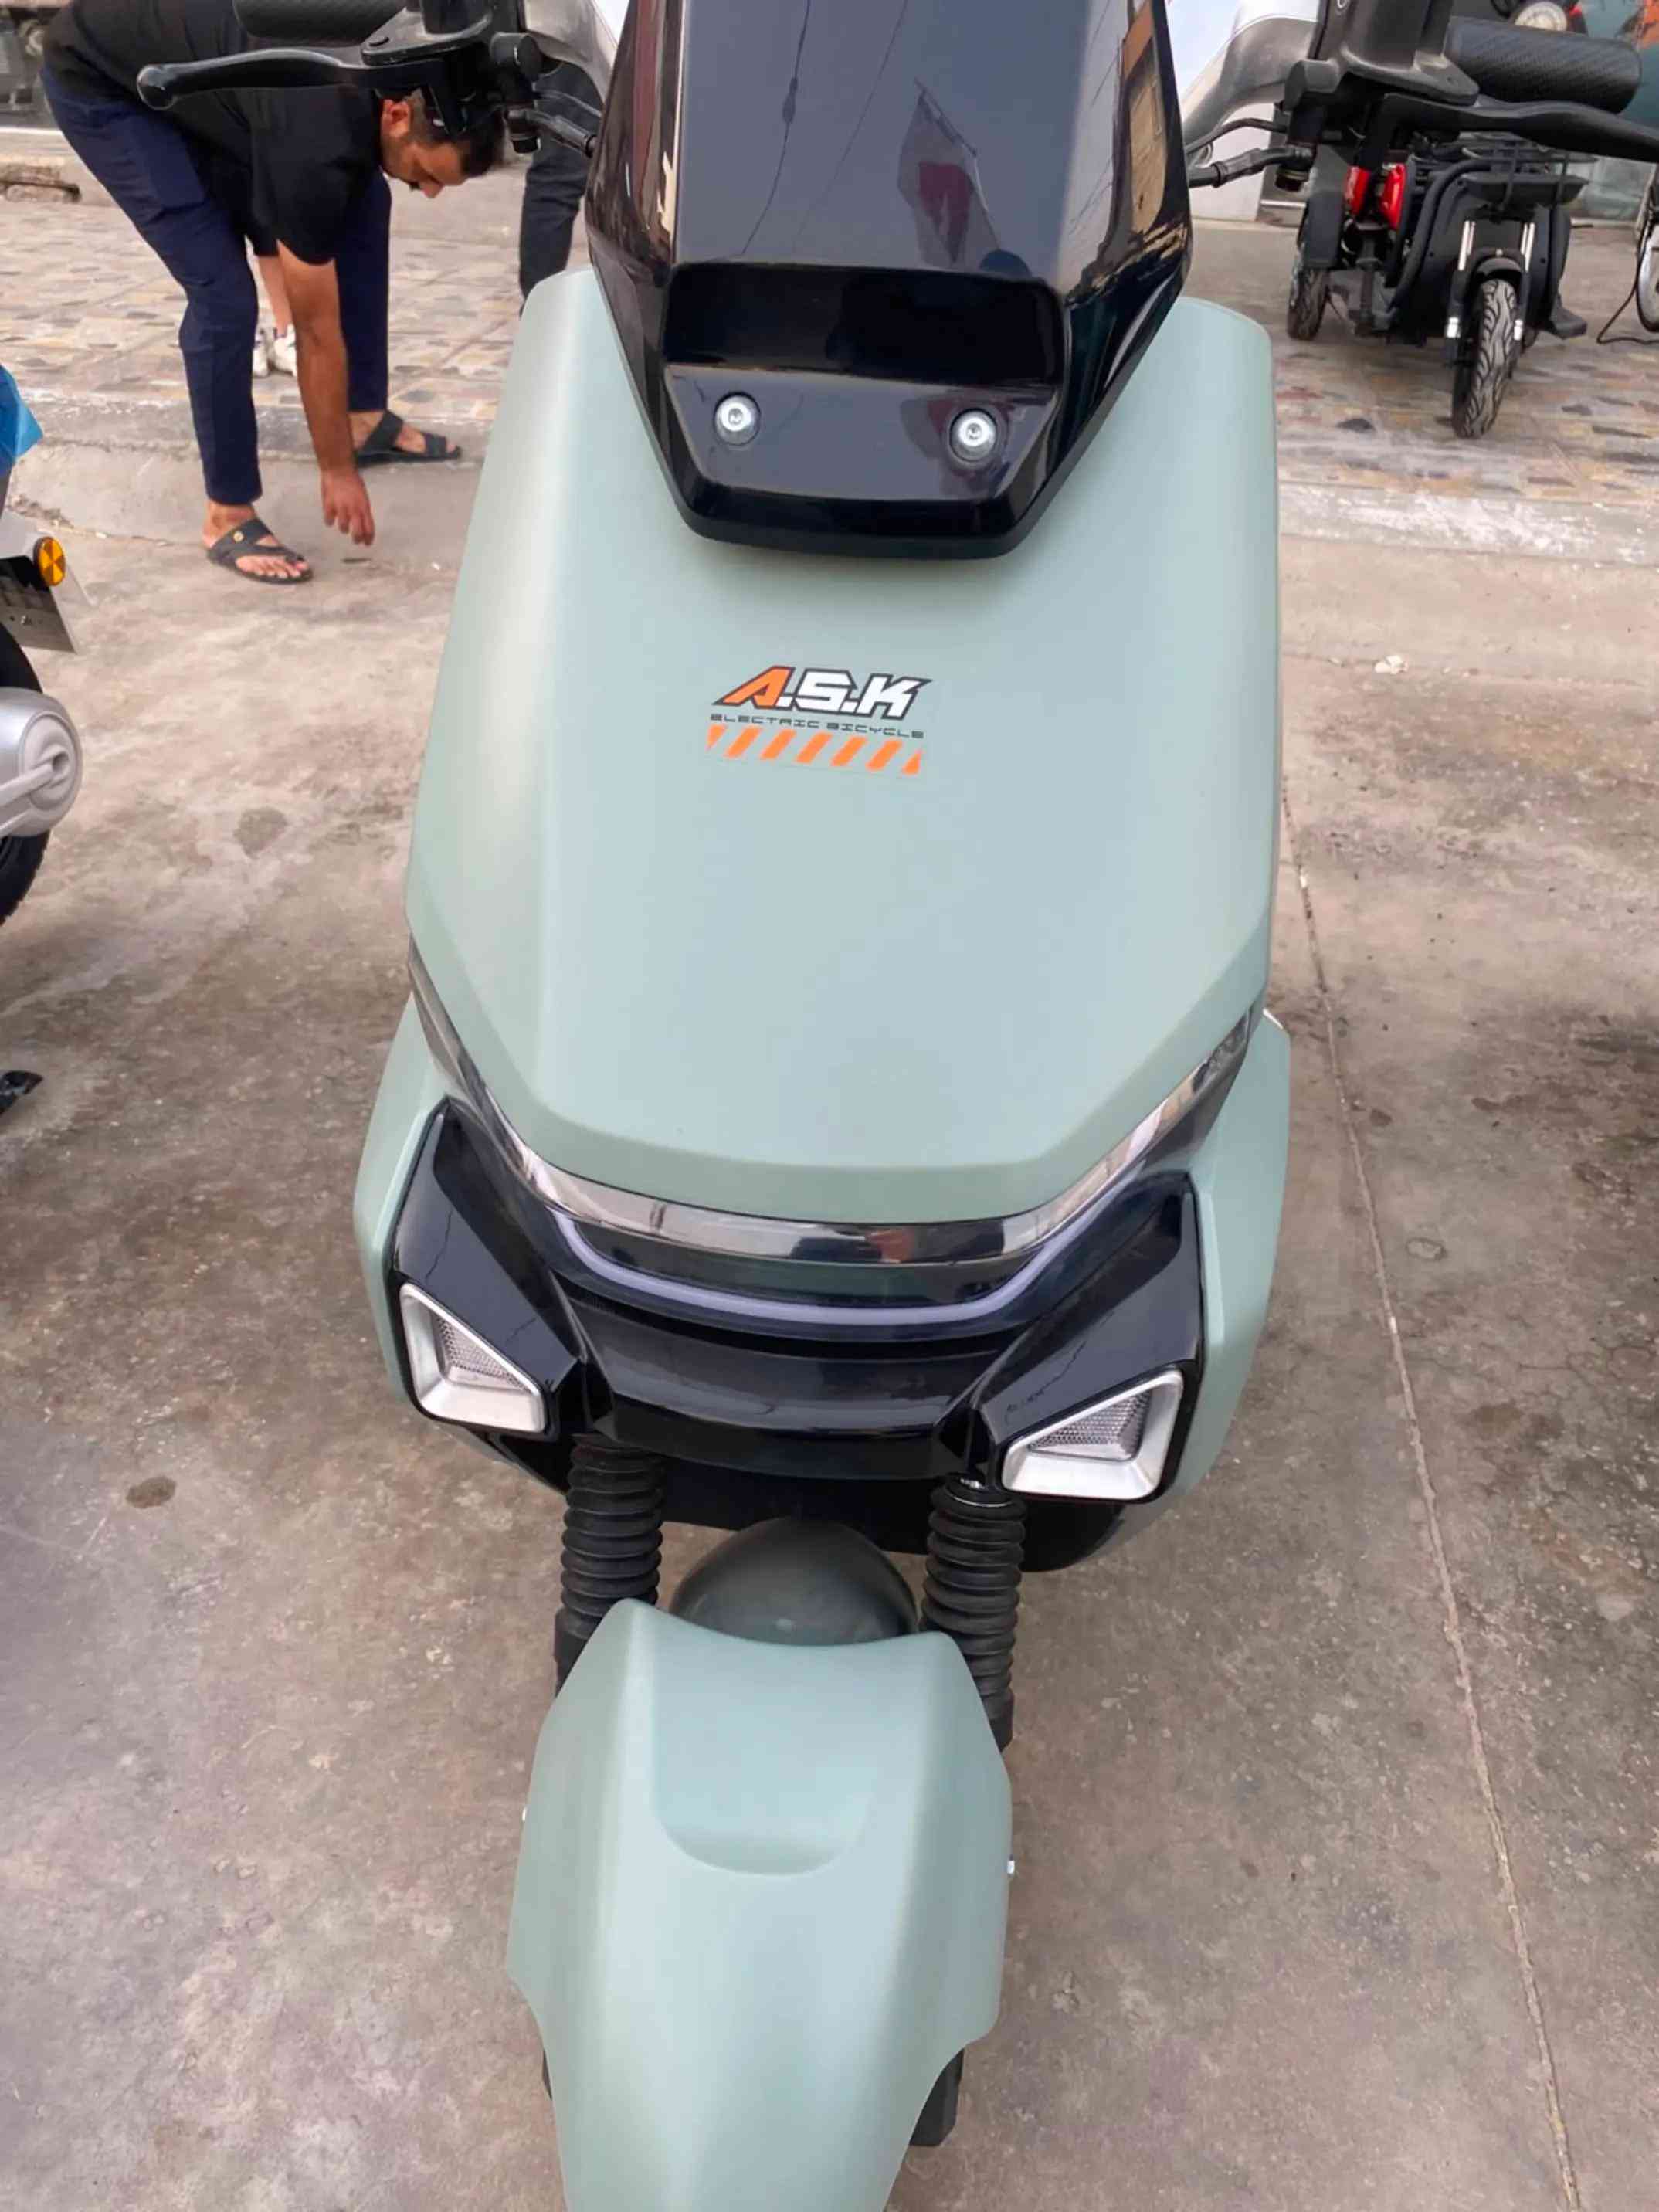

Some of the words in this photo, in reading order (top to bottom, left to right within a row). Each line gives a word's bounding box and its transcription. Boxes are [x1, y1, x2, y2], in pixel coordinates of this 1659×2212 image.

[711, 665, 933, 720] A.S.K
[710, 714, 819, 728] ELECTRIC
[826, 722, 924, 738] BICYCLE
